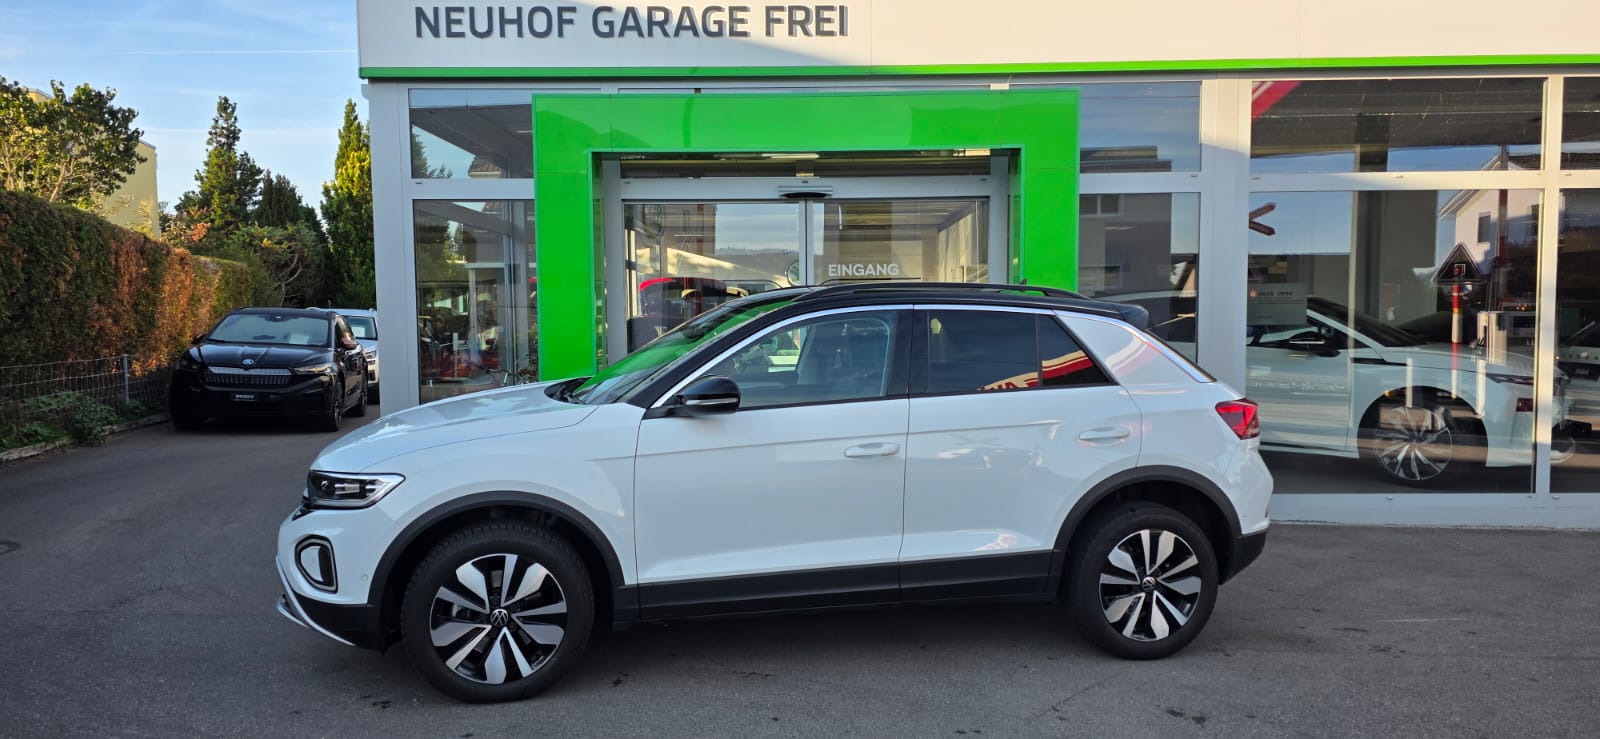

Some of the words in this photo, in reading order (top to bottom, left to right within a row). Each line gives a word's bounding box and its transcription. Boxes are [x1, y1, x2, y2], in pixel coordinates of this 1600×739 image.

[415, 6, 577, 38] NEUHOF
[592, 6, 751, 38] GARAGE
[765, 5, 848, 37] FREI
[828, 263, 900, 277] EINGANG
